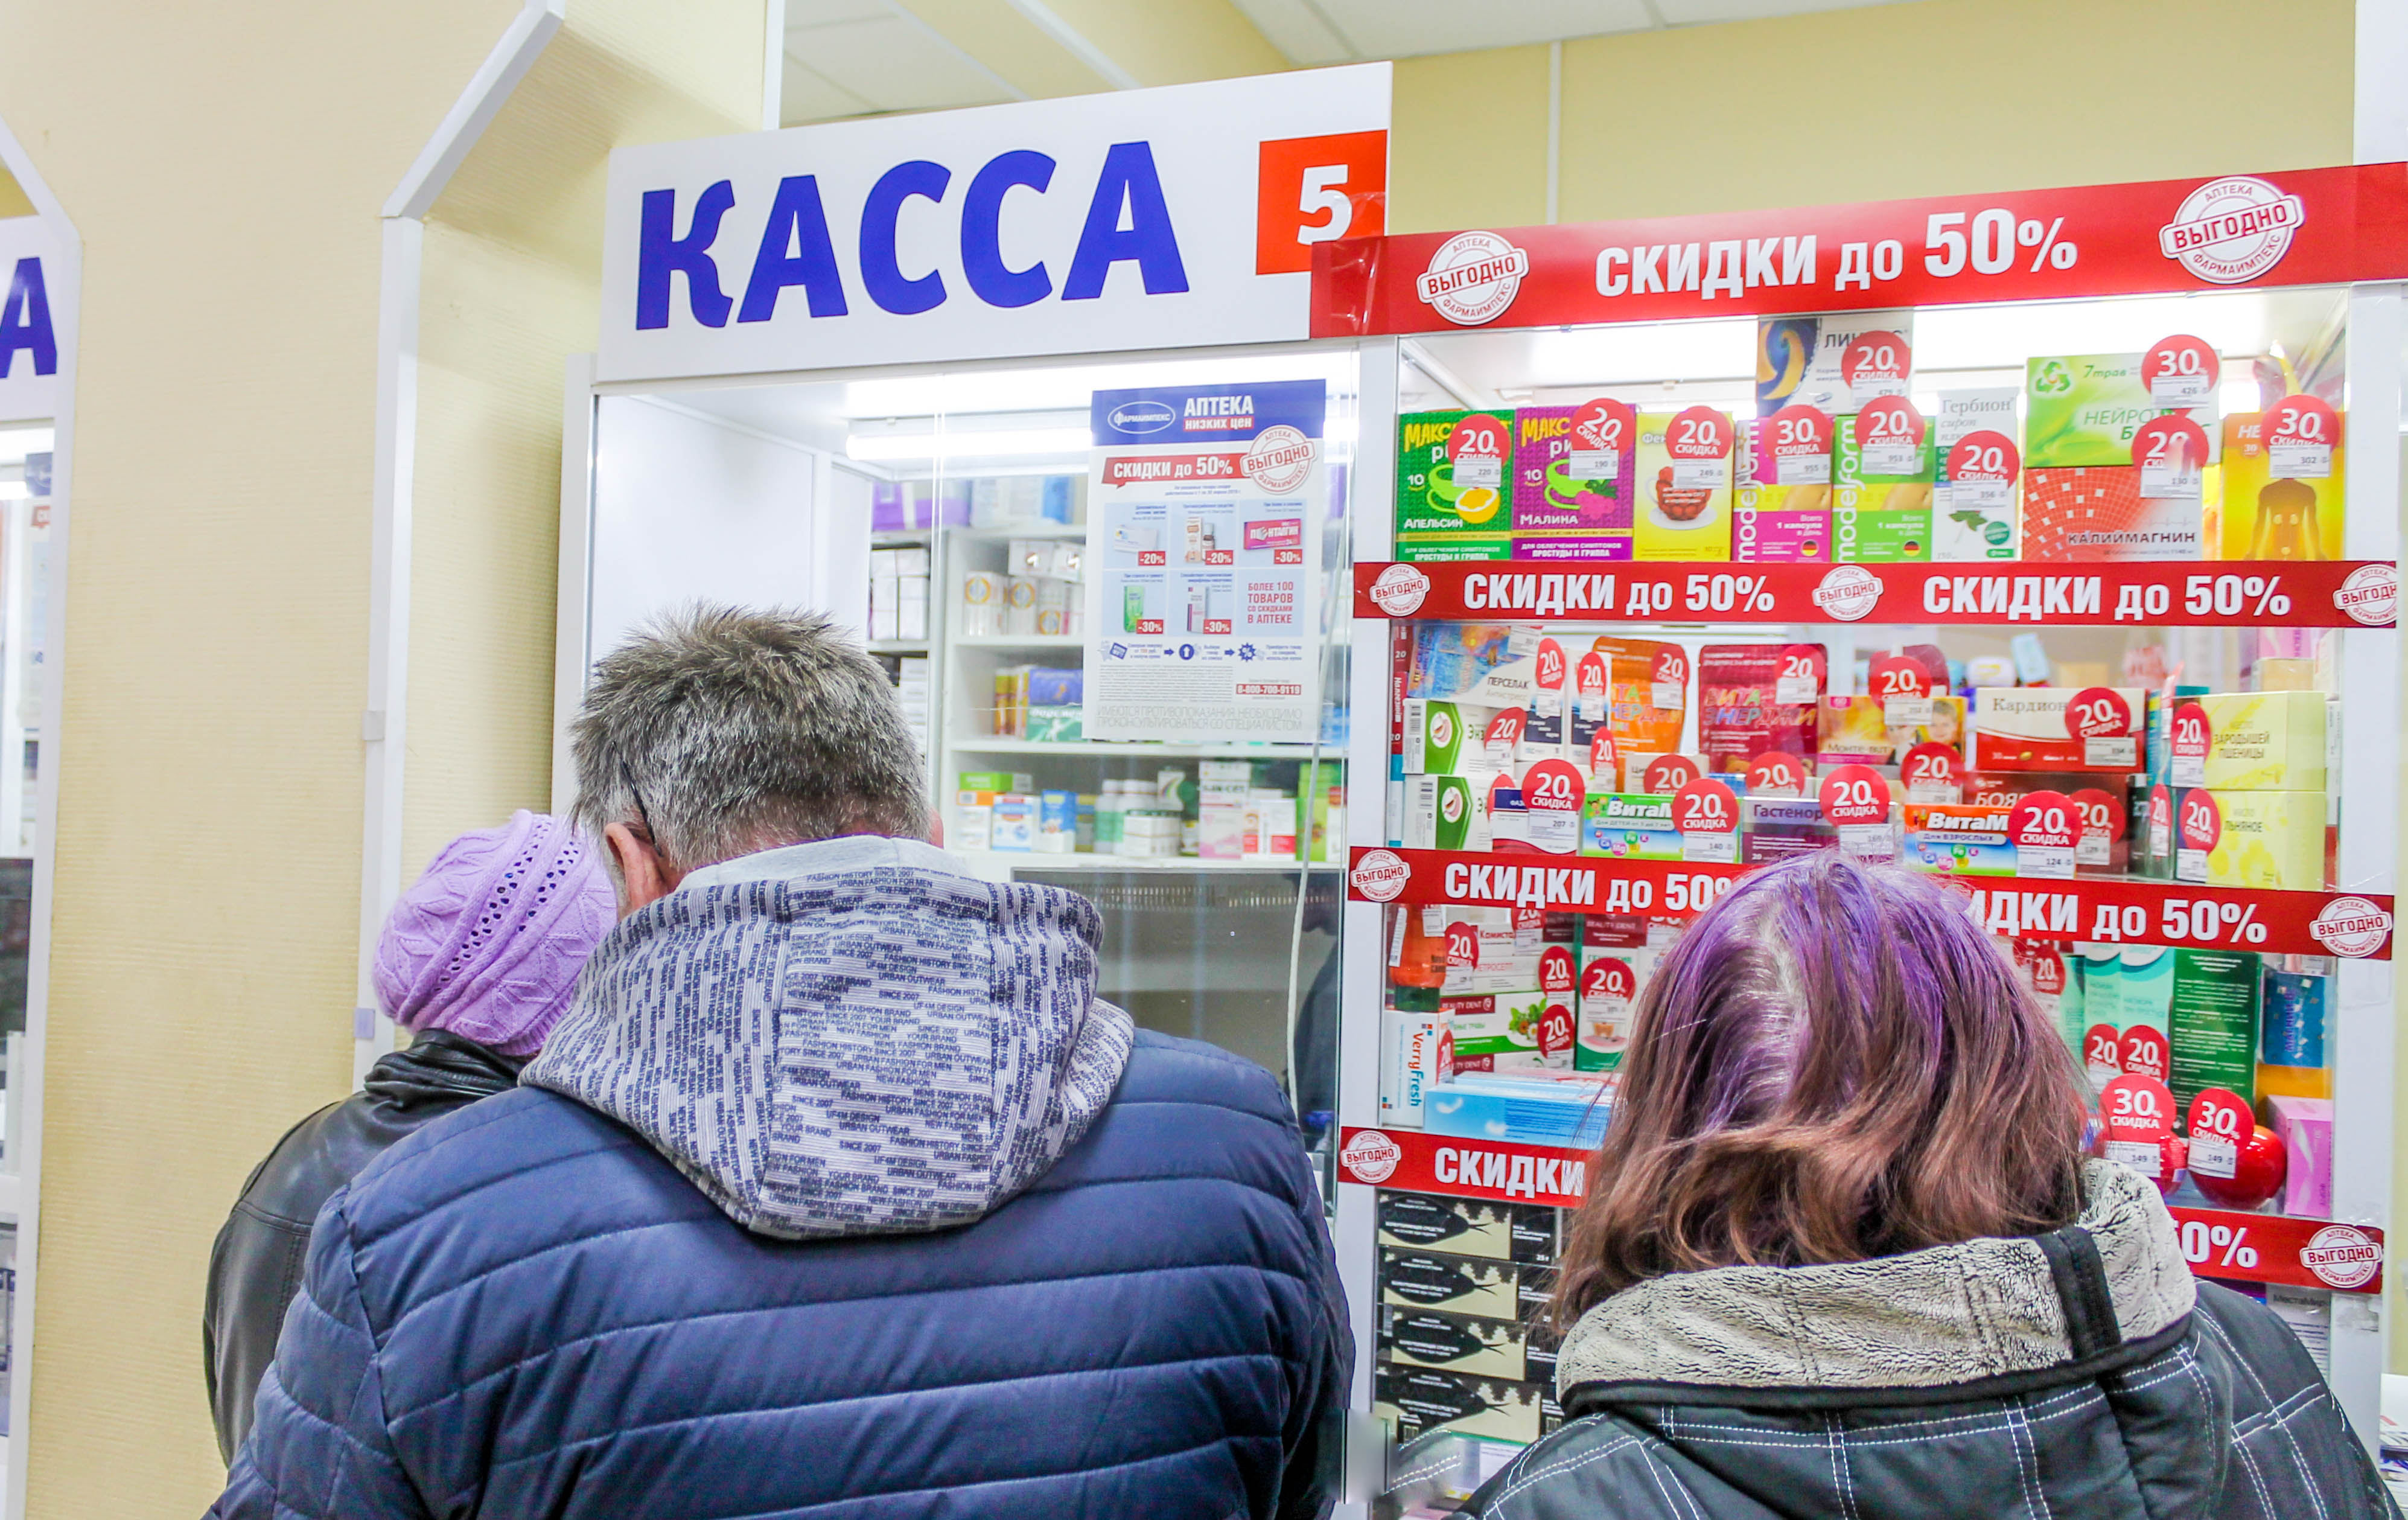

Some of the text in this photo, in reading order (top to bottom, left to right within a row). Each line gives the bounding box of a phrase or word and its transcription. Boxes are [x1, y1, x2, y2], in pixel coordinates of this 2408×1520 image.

[2205, 184, 2253, 202] АПТЕКА
[1297, 164, 1354, 245] 5
[636, 141, 1190, 330] КАССА
[2174, 205, 2287, 249] ВЫГОДНО
[1453, 238, 1491, 253] АПТЕКА
[1596, 208, 2078, 300] СКИДКИ до 50%
[2193, 235, 2281, 275] ФАРМАИМПЕКС
[1428, 257, 1515, 294] ВЫГОДНО
[1444, 283, 1511, 318] ФАРМАИМПЕКС
[1183, 395, 1254, 417] АПТЕКА
[1185, 417, 1253, 430] низких цен
[1265, 430, 1292, 440] АПТЕКА
[1247, 445, 1310, 471] ВЫГОДНО
[1675, 444, 1719, 456] СКИДКА
[1774, 444, 1820, 456] СКИДКА
[1113, 456, 1234, 480] СКИДКИ до 50%
[1258, 464, 1306, 489] ФАРМАИМПЕКС
[1524, 468, 1542, 482] 10
[1407, 473, 1424, 486] 10
[1404, 518, 1464, 529] АПЕЛЬСИН
[1520, 514, 1579, 526] МАЛИНА
[2068, 530, 2196, 544] КАЛИЙМАГНИН
[1139, 552, 1165, 565] -20%
[1207, 552, 1232, 564] -20%
[1275, 550, 1301, 563] -30%
[1248, 581, 1293, 592] БОЛЕЕ 100
[1376, 580, 1423, 598] ВЫГОДНО
[1464, 573, 1615, 616] СКИДКИ
[1626, 582, 1674, 616] до
[1686, 574, 1774, 613] 50%
[1820, 583, 1875, 601] ВЫГОДНО
[2342, 584, 2397, 604] ВЫГОДН
[1248, 593, 1293, 604] ТОВАРОВ
[1923, 574, 2292, 621] СКИДКИ до 50%
[1138, 621, 1162, 633] -30%
[1205, 621, 1230, 633] -30%
[1248, 614, 1293, 624] В АПТЕКЕ
[1534, 772, 1575, 799] 20%
[1832, 780, 1879, 807] 20%
[1531, 797, 1573, 810] СКИДКА
[1684, 794, 1728, 819] 20%
[1754, 804, 1824, 820] Гастенор
[1832, 805, 1879, 817] СКИДКА
[1683, 819, 1727, 830] СКИДКА
[2022, 806, 2072, 835] 20%
[2019, 834, 2069, 846] СКИДКА
[1356, 866, 1404, 883] ВЫГОДНО
[1445, 863, 1595, 909] СКИДКИ
[1606, 878, 1652, 913] до
[2091, 905, 2147, 940] до
[2161, 898, 2267, 944] 50%
[2318, 916, 2383, 935] ВЫГОДНО
[2112, 1088, 2162, 1118] 30%
[2110, 1116, 2160, 1129] СКИДКА
[1347, 1148, 1394, 1163] ВЫГОДНО
[1435, 1147, 1586, 1199] СКИДКИ
[2173, 1219, 2258, 1268] 0%
[2308, 1247, 2374, 1263] ВЫГОДНО
